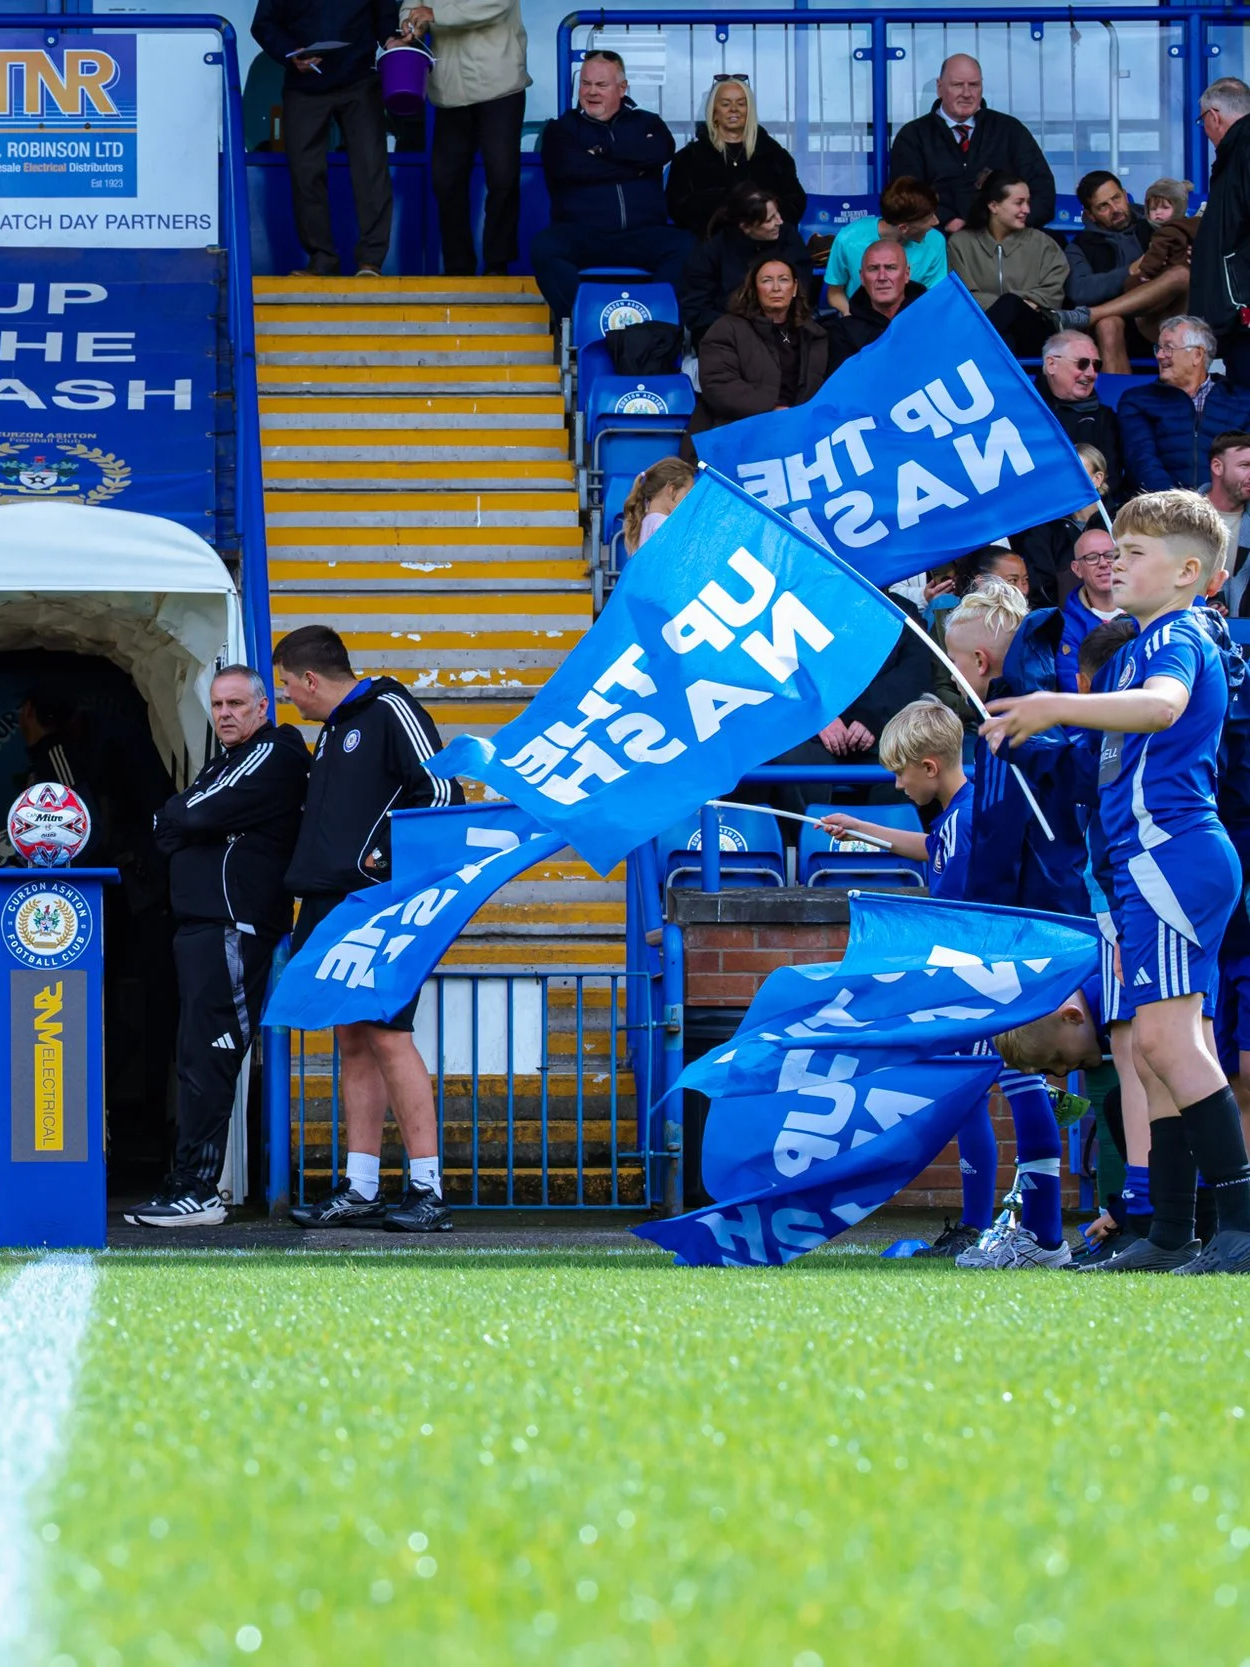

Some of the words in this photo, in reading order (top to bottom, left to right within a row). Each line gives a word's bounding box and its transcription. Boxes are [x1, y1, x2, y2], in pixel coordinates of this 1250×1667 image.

[7, 141, 90, 158] ROBINSON
[95, 141, 124, 158] LTD
[23, 162, 67, 173] Electrical
[69, 162, 124, 173] Distributors
[90, 178, 103, 189] Est
[104, 178, 124, 189] 1923
[60, 214, 99, 231] DAY
[106, 214, 212, 230] PARTNERS
[34, 813, 63, 822] Mitre
[7, 882, 47, 912] CURZON
[51, 883, 87, 917] ASHTON
[7, 933, 58, 967] FOOTBALL
[61, 936, 85, 961] CLUB
[42, 1048, 56, 1146] ELECTRICAL
